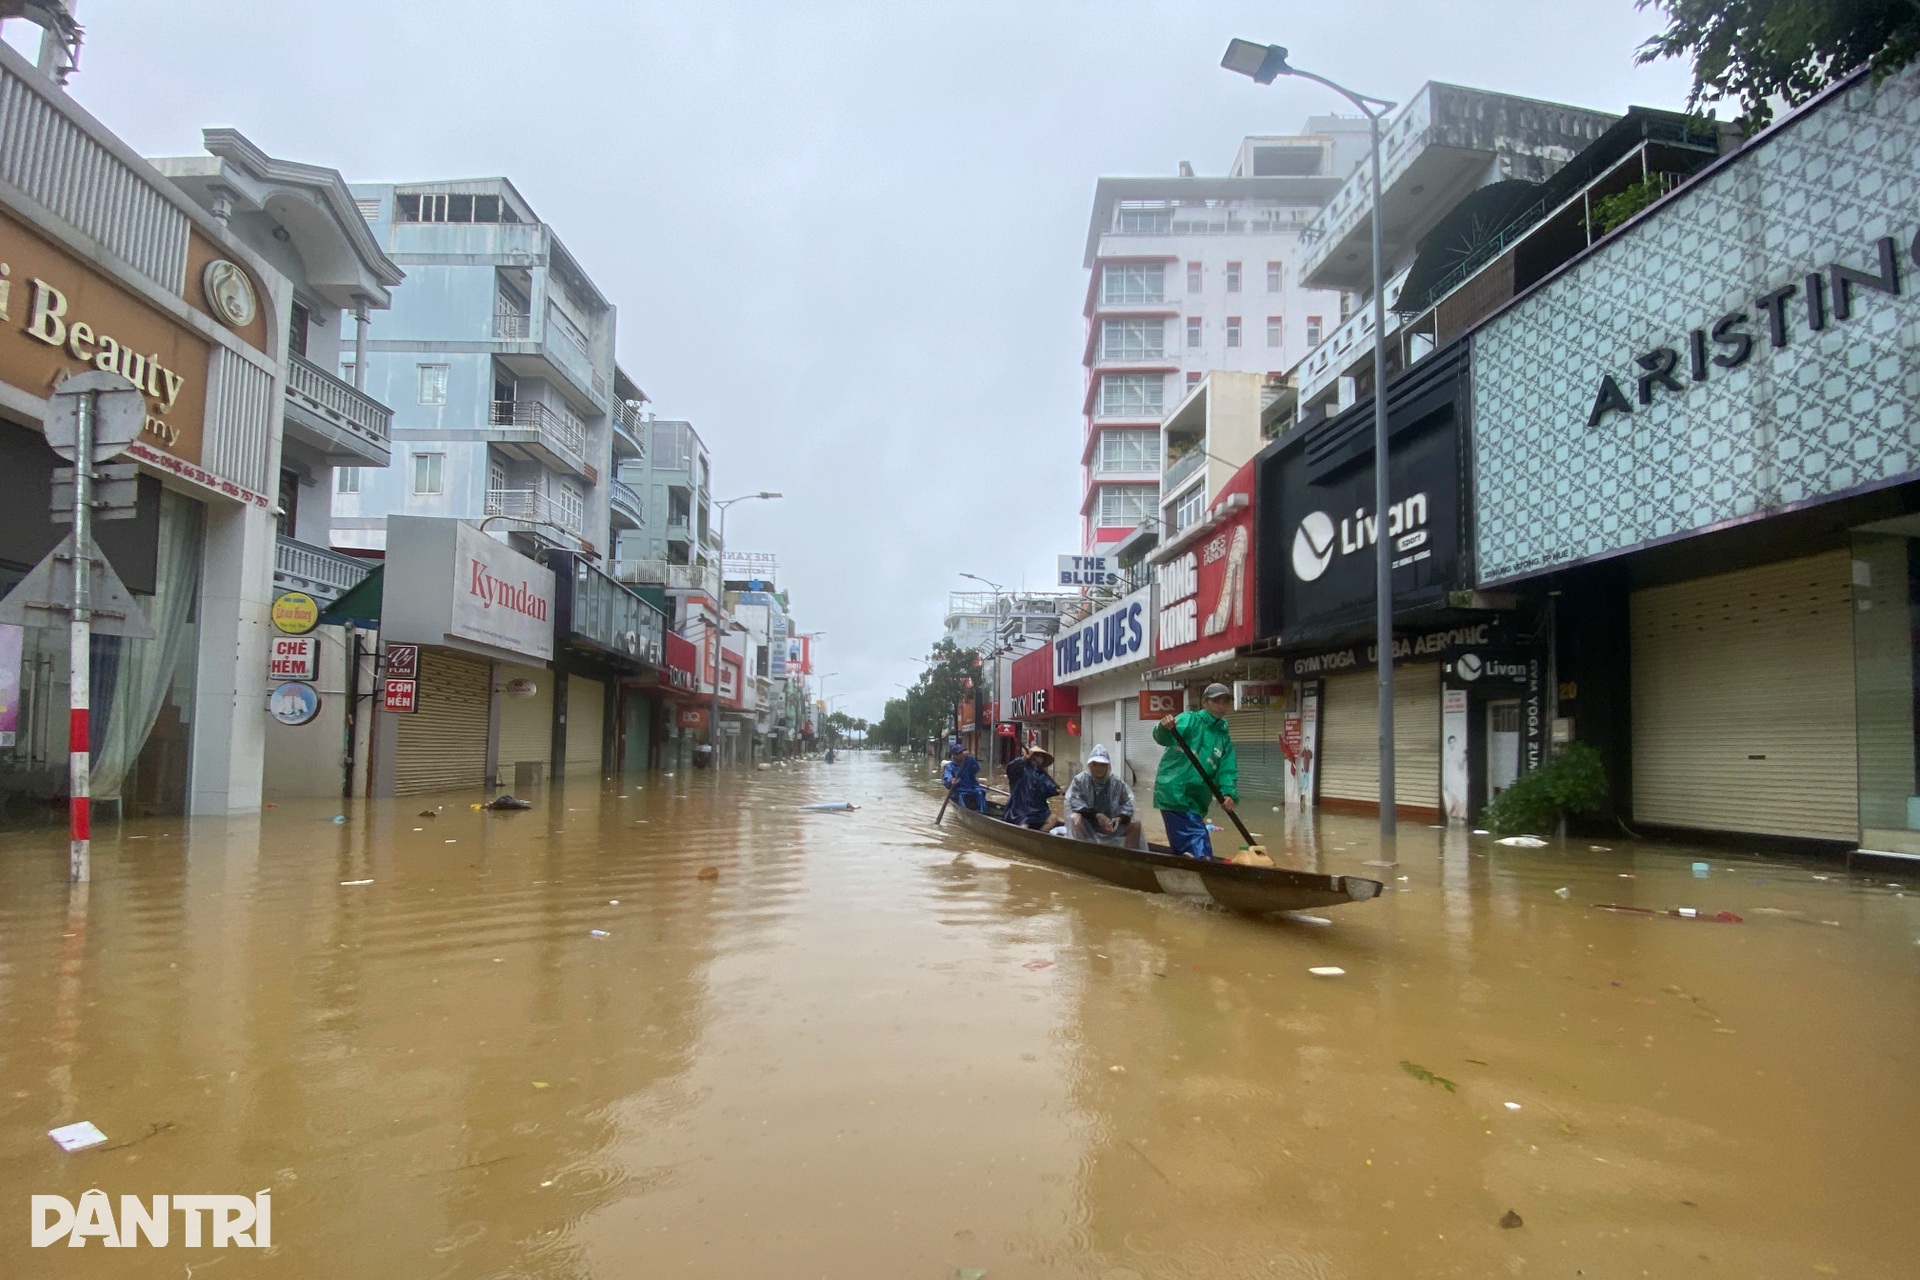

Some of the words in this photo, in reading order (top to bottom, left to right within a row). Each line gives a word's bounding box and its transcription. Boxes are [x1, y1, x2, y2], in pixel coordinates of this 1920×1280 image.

[1587, 228, 1920, 427] ARISTIN
[25, 277, 185, 414] Beauty
[1341, 492, 1427, 556] Livan
[1203, 534, 1226, 556] SHOES
[1203, 546, 1226, 567] FASHION
[1060, 571, 1118, 586] BLUES
[1071, 556, 1106, 570] THE
[1159, 552, 1197, 607] HONG
[470, 559, 547, 622] Kymdan
[1055, 630, 1081, 676] THE
[1082, 602, 1142, 668] BLUES
[1159, 599, 1197, 651] KONG
[277, 640, 308, 655] CHÈ
[626, 630, 662, 665] OWEN
[1294, 656, 1321, 674] GYM
[1322, 649, 1357, 670] YOGA
[1367, 638, 1412, 663] UBA
[1486, 660, 1527, 675] Livan
[683, 711, 700, 722] BQ
[1150, 695, 1174, 711] BQ
[1527, 696, 1539, 737] YOGA
